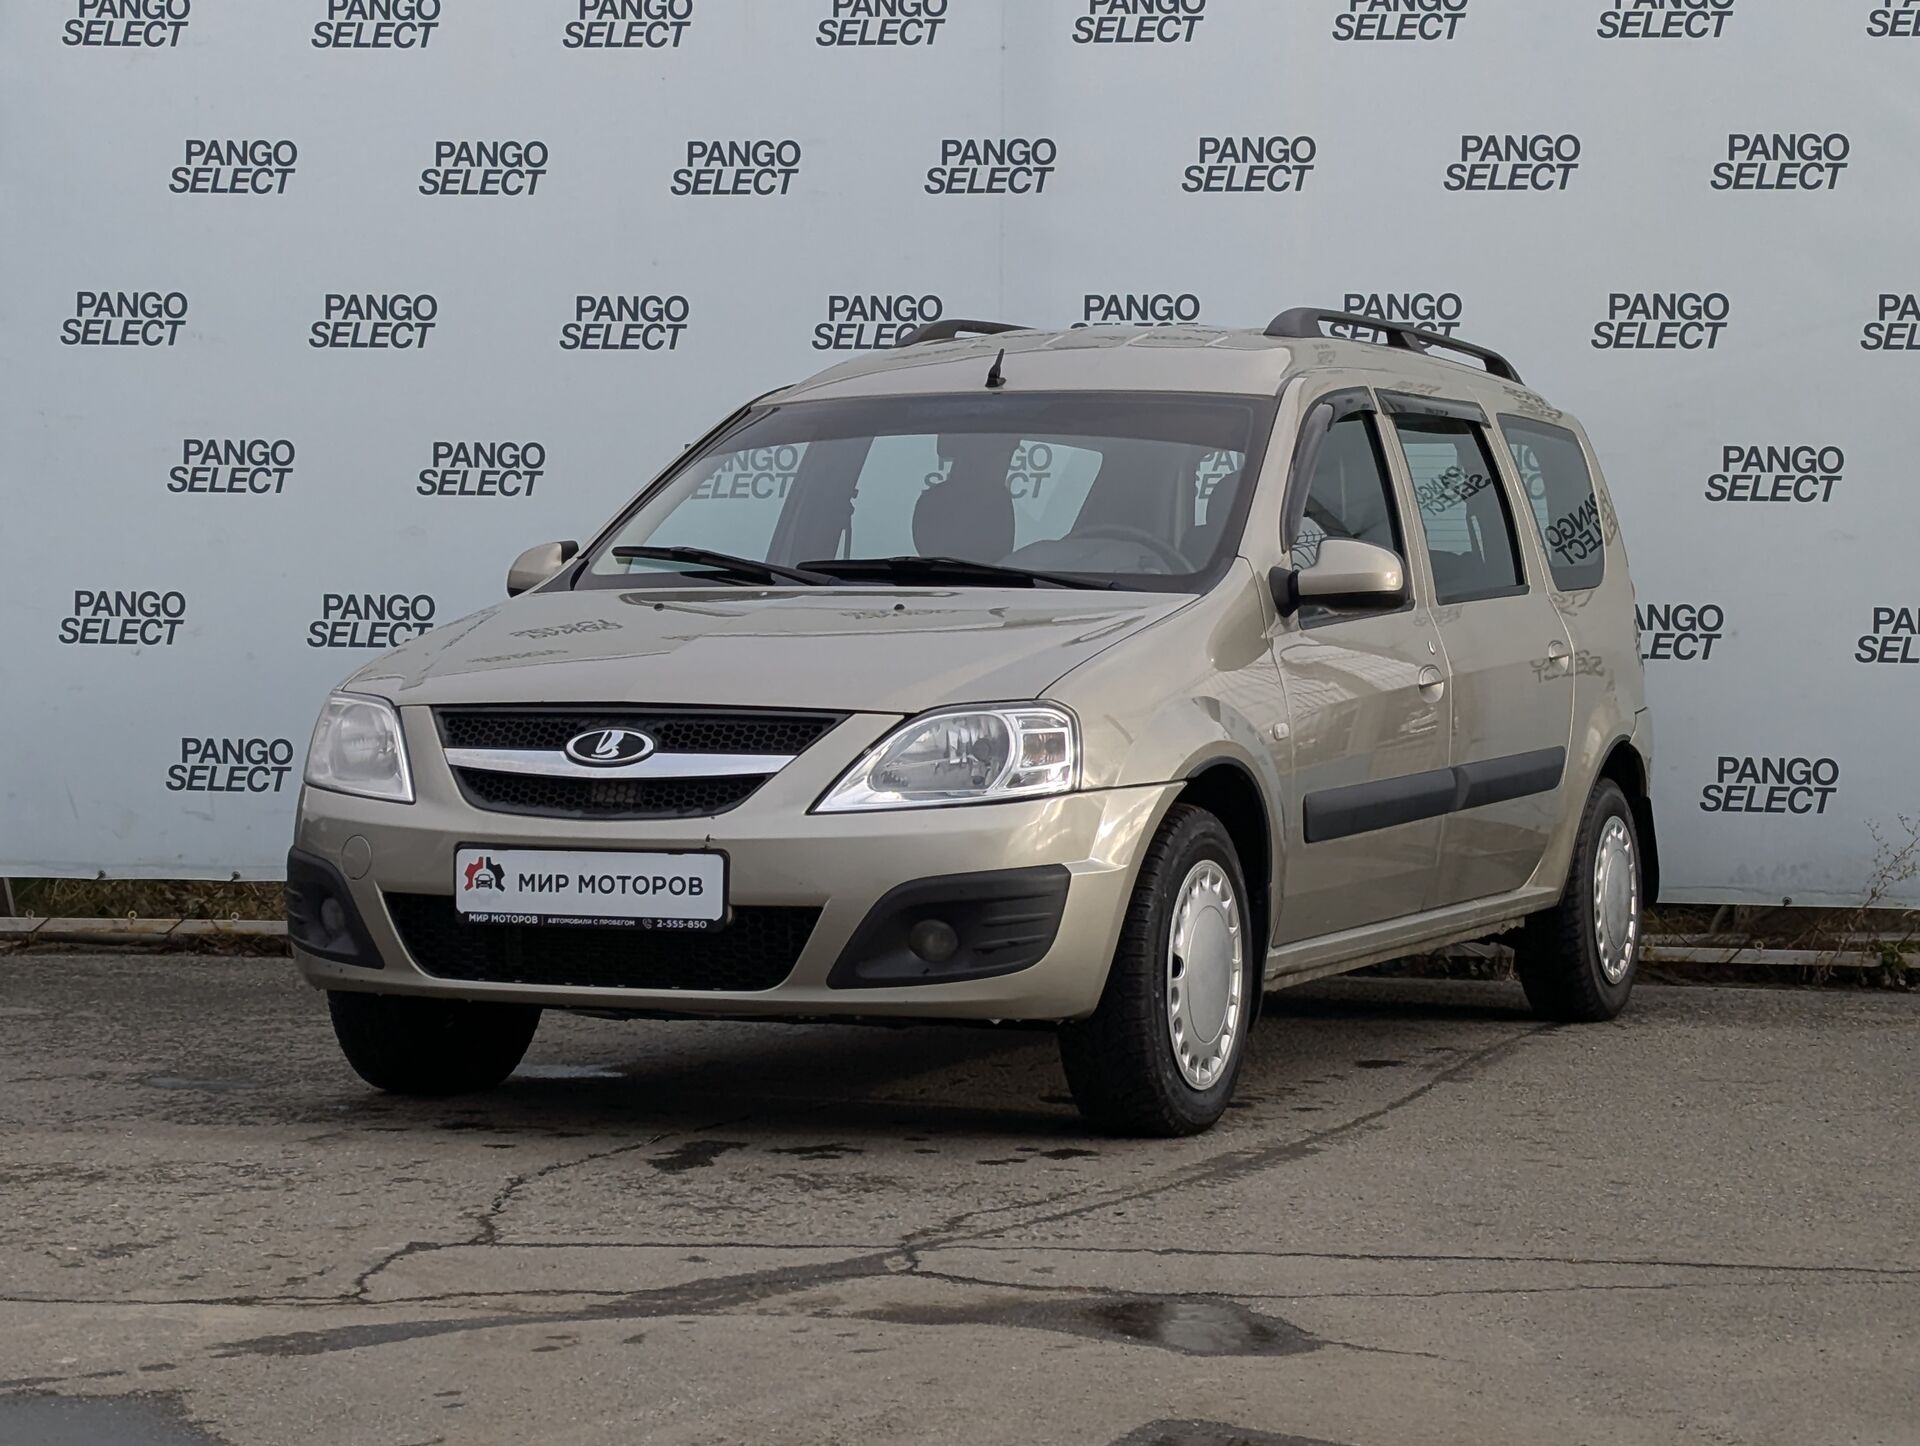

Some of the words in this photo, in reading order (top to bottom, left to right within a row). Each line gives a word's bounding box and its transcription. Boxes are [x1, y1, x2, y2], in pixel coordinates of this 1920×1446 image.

[79, 0, 190, 20] PANGO
[329, 0, 440, 20] PANGO
[580, 0, 692, 20] PANGO
[62, 20, 188, 47] SELECT
[312, 22, 438, 48] SELECT
[563, 21, 691, 48] SELECT
[816, 19, 945, 46] SELECT
[1072, 16, 1203, 43] SELECT
[1333, 13, 1466, 40] SELECT
[1597, 11, 1733, 38] SELECT
[186, 140, 297, 166] PANGO
[436, 141, 548, 167] PANGO
[688, 140, 800, 167] PANGO
[942, 139, 1056, 165] PANGO
[1200, 136, 1316, 163] PANGO
[1462, 135, 1580, 162] PANGO
[1729, 134, 1849, 161] PANGO
[169, 167, 295, 194] SELECT
[419, 169, 546, 195] SELECT
[671, 169, 799, 195] SELECT
[925, 167, 1054, 194] SELECT
[1182, 165, 1314, 192] SELECT
[1444, 163, 1578, 190] SELECT
[1711, 163, 1847, 189] SELECT
[77, 292, 187, 318] PANGO
[326, 294, 437, 321] PANGO
[577, 296, 689, 322] PANGO
[829, 295, 942, 321] PANGO
[1085, 294, 1199, 321] PANGO
[1344, 293, 1462, 320] PANGO
[1609, 293, 1729, 320] PANGO
[61, 319, 186, 346] SELECT
[309, 322, 435, 348] SELECT
[560, 323, 687, 350] SELECT
[1591, 322, 1727, 349] SELECT
[184, 440, 295, 466] PANGO
[433, 442, 545, 469] PANGO
[1723, 446, 1844, 474] PANGO
[167, 466, 293, 493] SELECT
[417, 469, 544, 496] SELECT
[1705, 474, 1842, 502] SELECT
[75, 591, 185, 618] PANGO
[324, 594, 435, 621] PANGO
[59, 618, 184, 645] SELECT
[182, 738, 293, 765] PANGO
[166, 765, 292, 792] SELECT
[1718, 757, 1839, 786] PANGO
[1699, 785, 1837, 814] SELECT
[518, 873, 570, 893] МИР
[578, 875, 704, 896] МОТОРОВ
[468, 913, 489, 923] МИР
[491, 914, 538, 925] МОТОРОВ
[656, 919, 708, 929] 2-555-850
